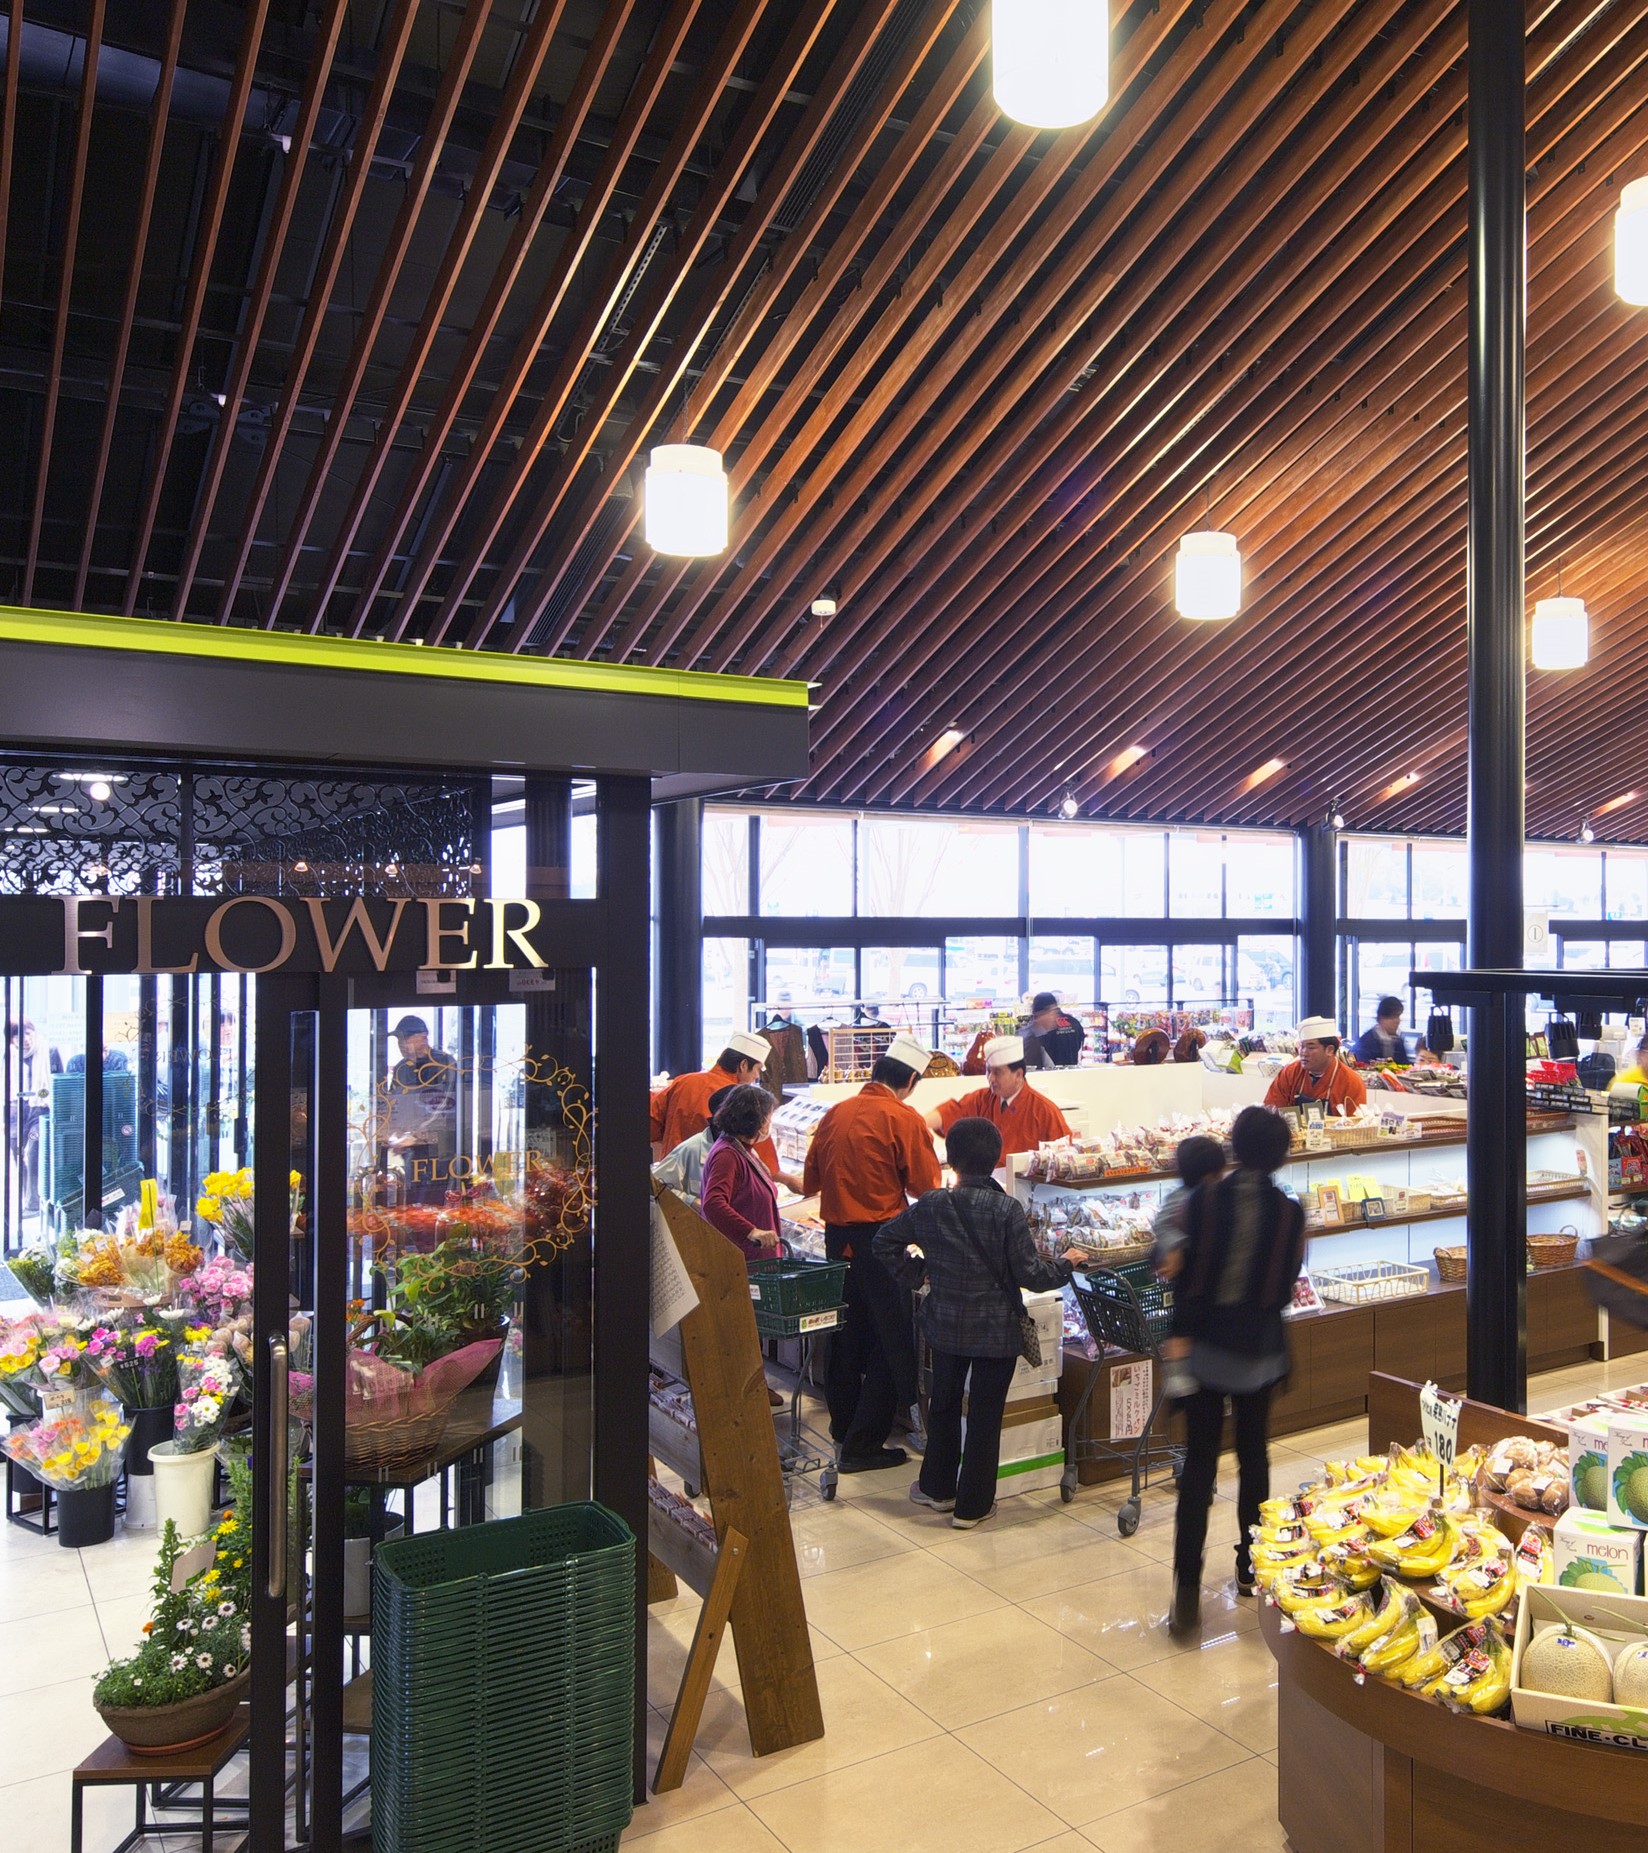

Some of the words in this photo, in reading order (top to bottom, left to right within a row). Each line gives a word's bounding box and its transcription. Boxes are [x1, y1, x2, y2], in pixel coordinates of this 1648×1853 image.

[51, 896, 549, 975] FLOWER
[412, 1150, 545, 1183] FLOWER
[1586, 1543, 1629, 1560] melon
